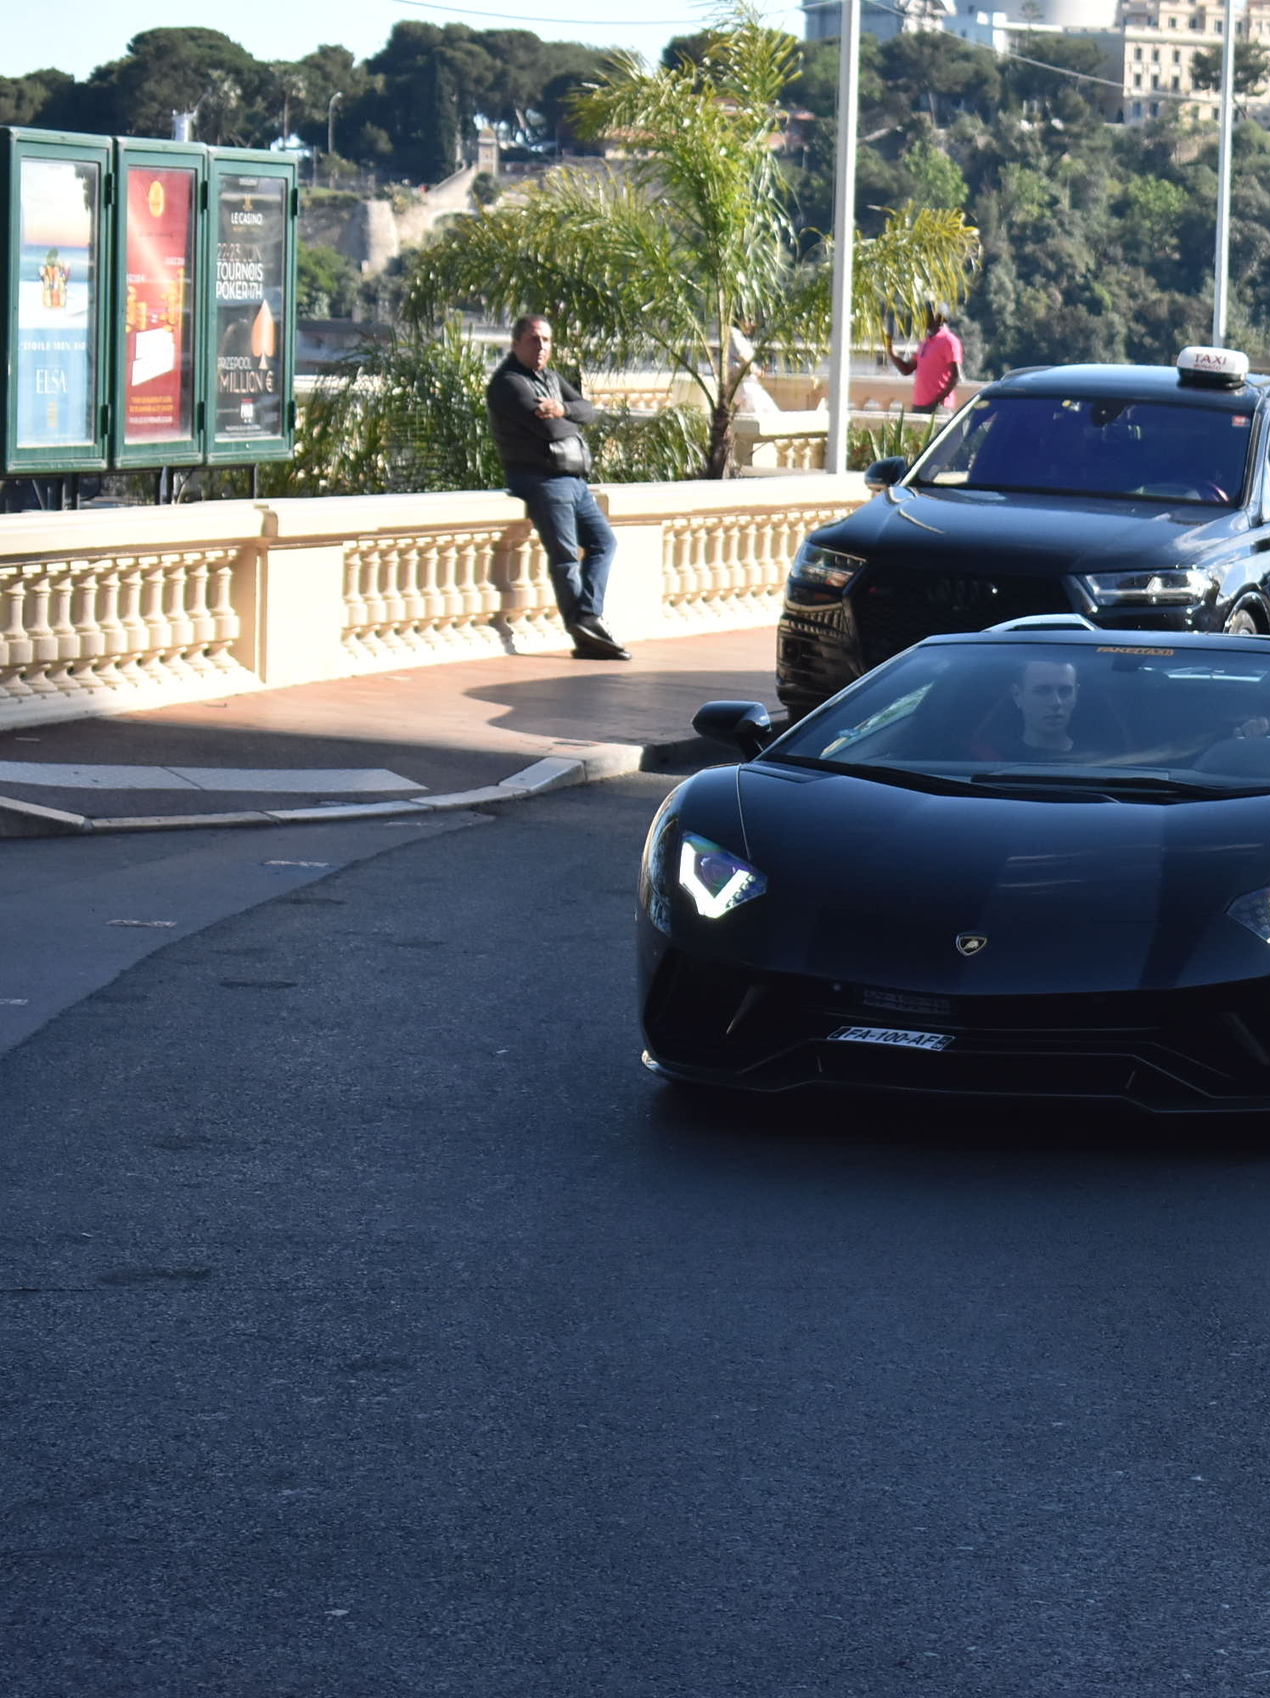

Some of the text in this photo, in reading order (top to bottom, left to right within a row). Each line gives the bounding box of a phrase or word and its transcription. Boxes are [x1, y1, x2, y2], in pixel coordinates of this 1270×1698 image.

[231, 212, 262, 225] LE CASINO
[217, 262, 263, 280] TOURNOIS
[1194, 353, 1228, 366] TAXI
[36, 369, 67, 394] ELSA
[219, 370, 274, 393] MILLION €
[844, 1029, 936, 1046] FA-100-AF
